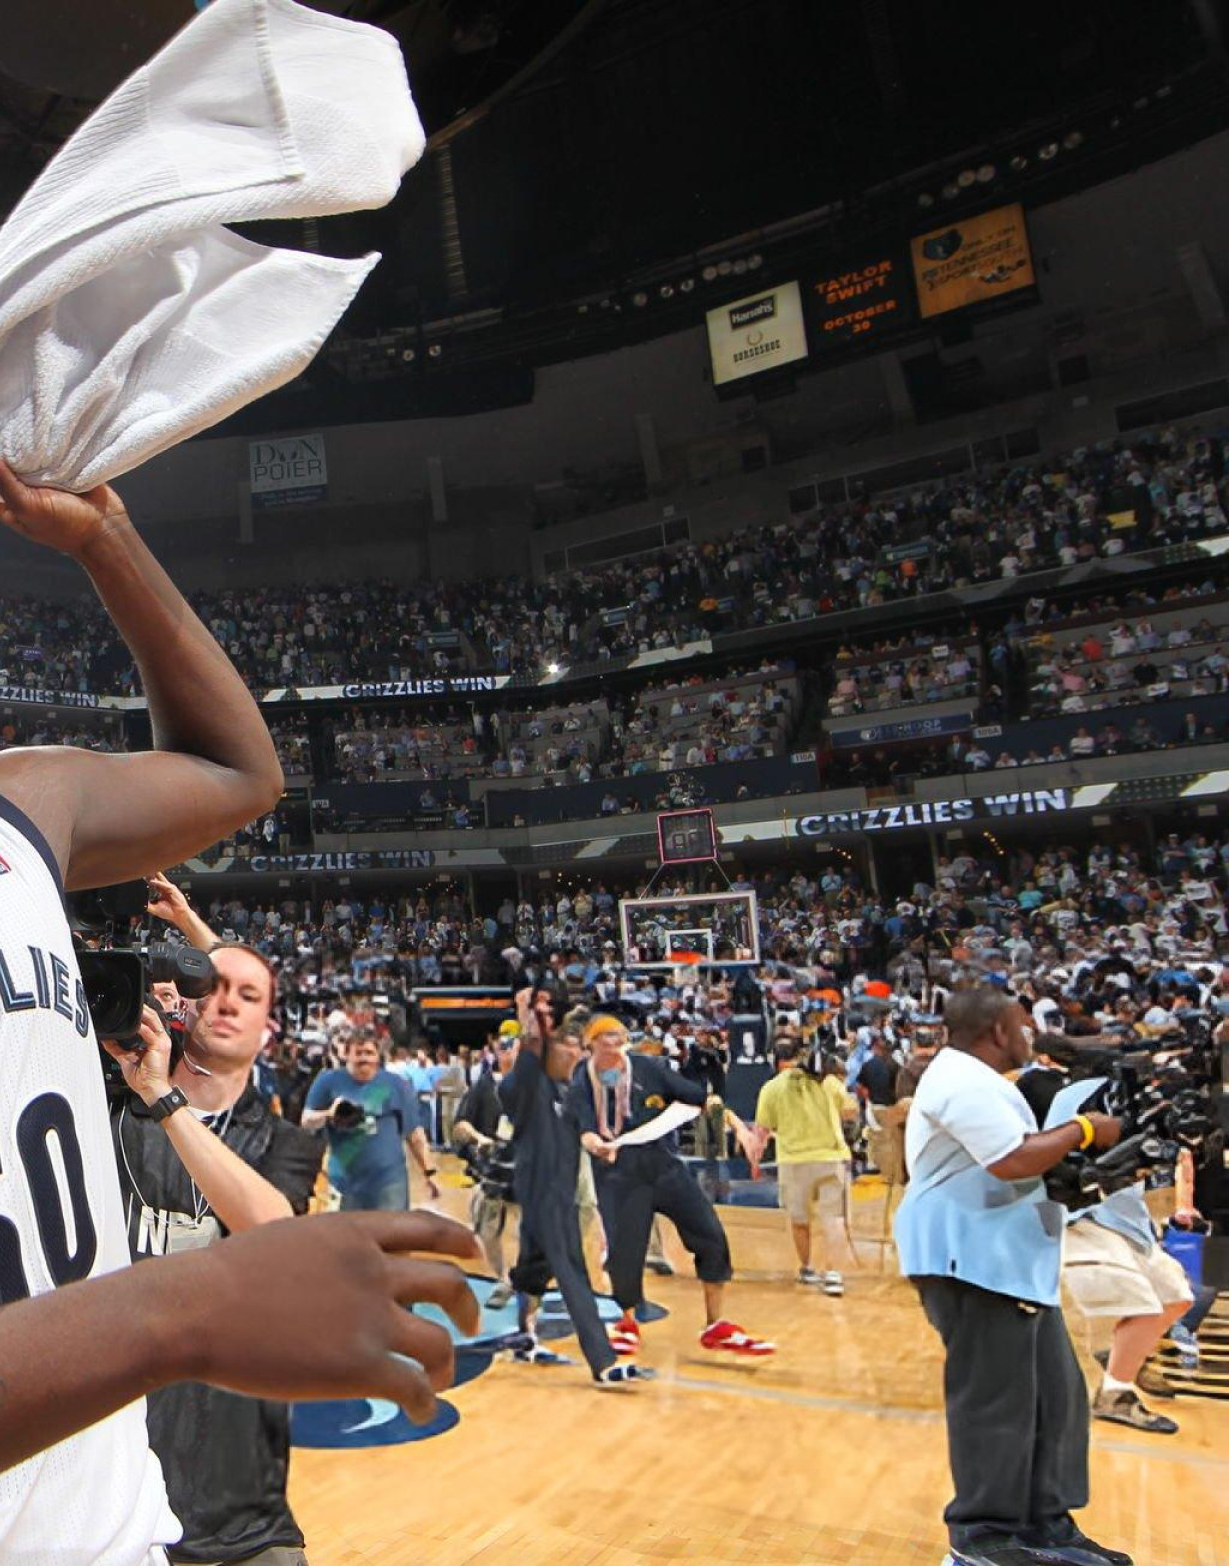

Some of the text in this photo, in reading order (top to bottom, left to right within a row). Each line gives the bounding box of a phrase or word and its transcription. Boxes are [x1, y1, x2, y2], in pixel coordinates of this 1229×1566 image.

[815, 258, 893, 294] TAYLOR
[825, 274, 888, 304] SWIFT
[823, 299, 897, 330] OCTOBER
[252, 458, 322, 482] POIER
[59, 692, 96, 708] WIN
[345, 677, 493, 698] GRIZZLIES WIN
[800, 788, 1067, 835] GRIZZLIES WIN
[250, 850, 431, 871] GRIZZLIES WIN
